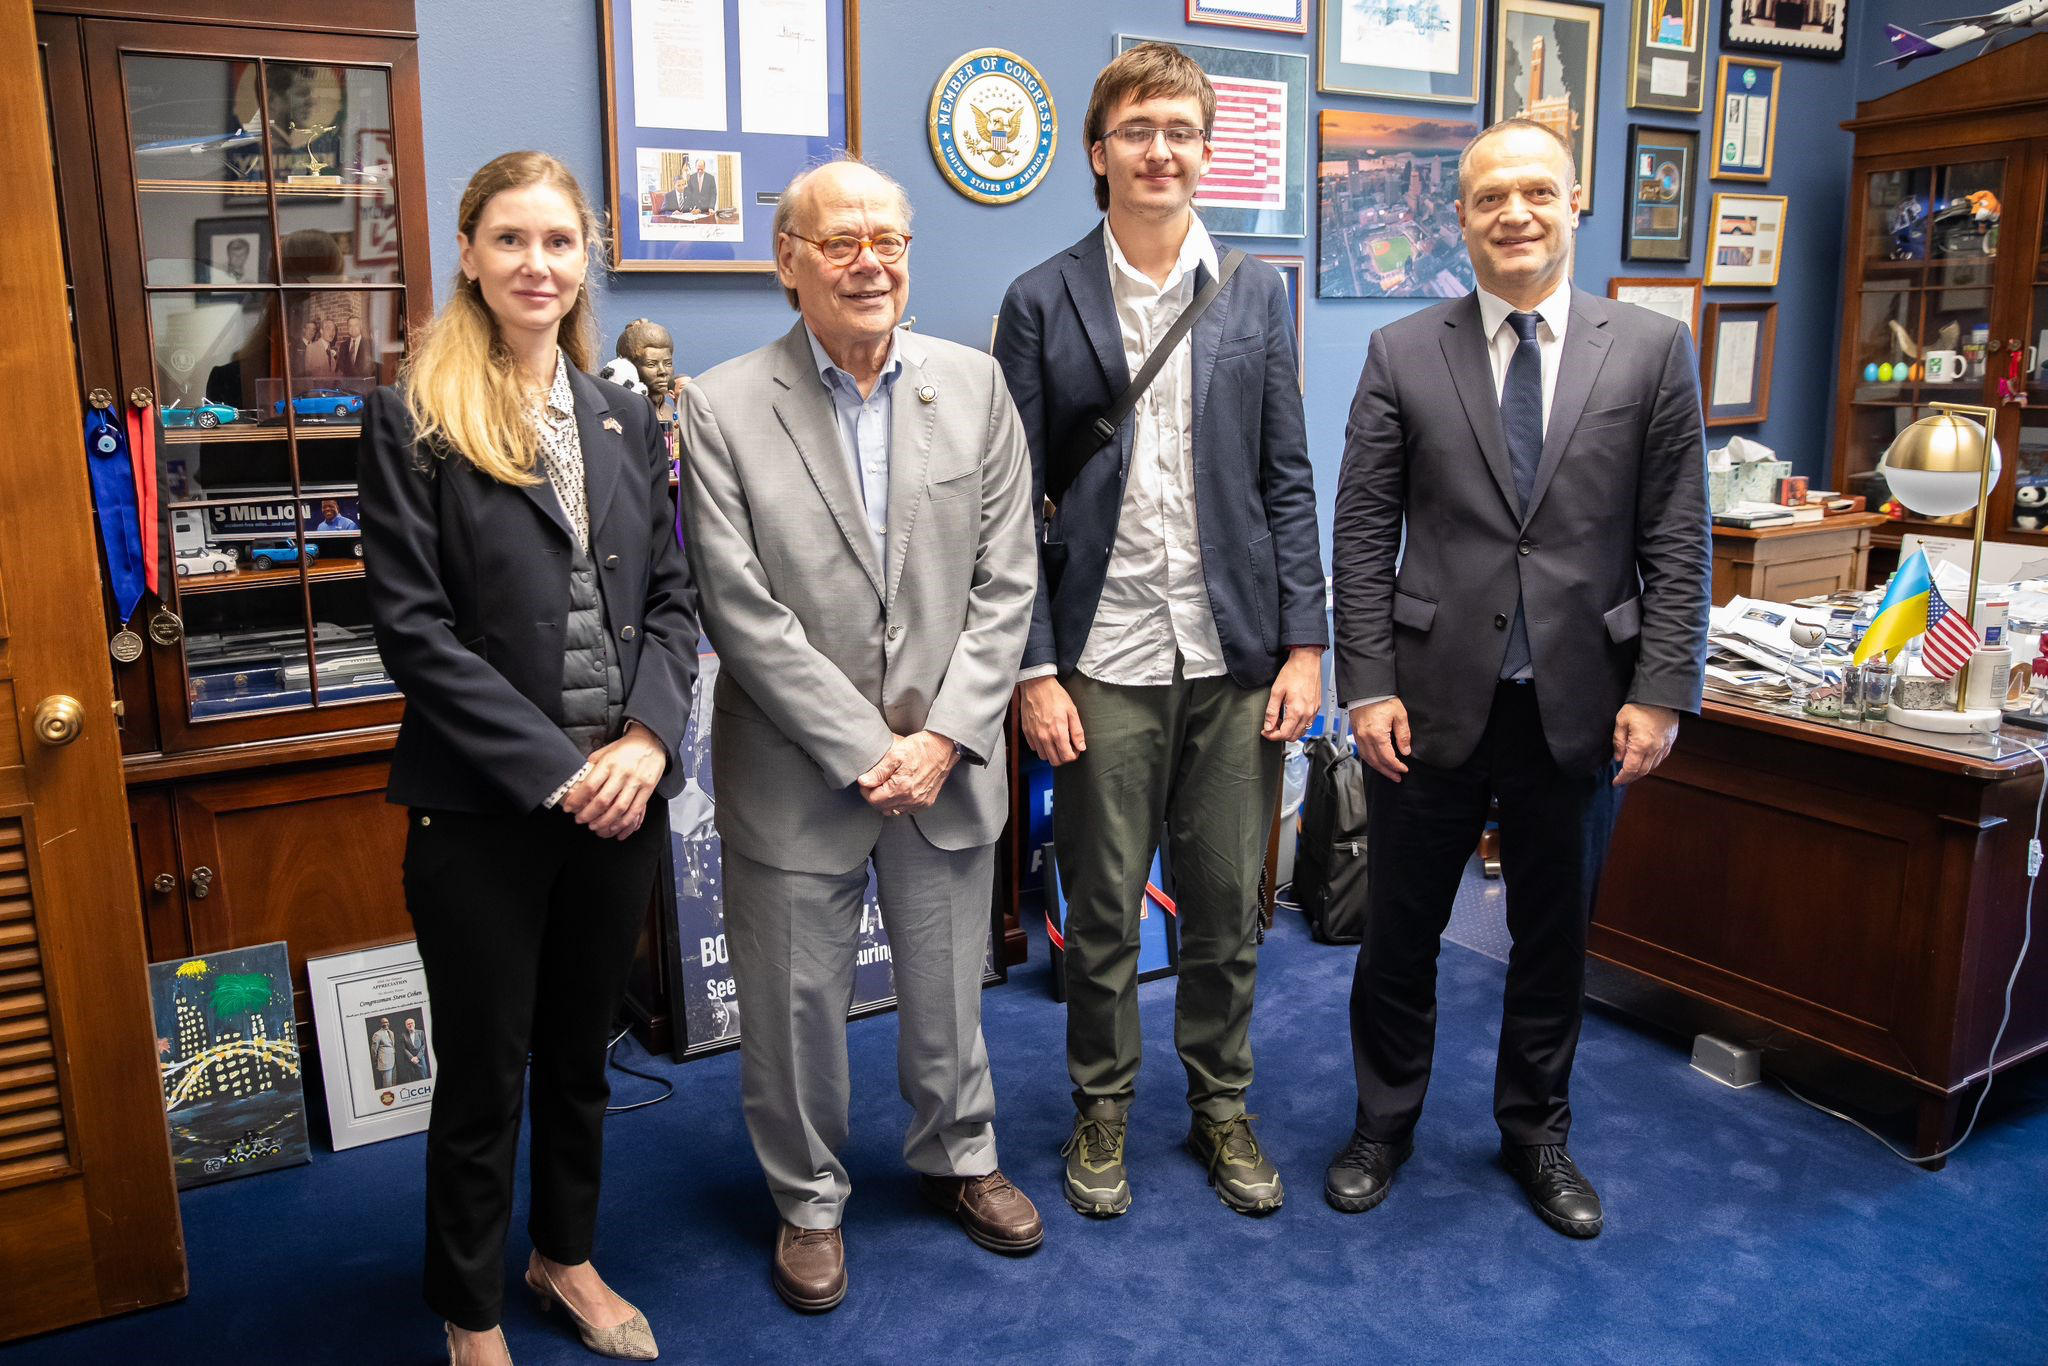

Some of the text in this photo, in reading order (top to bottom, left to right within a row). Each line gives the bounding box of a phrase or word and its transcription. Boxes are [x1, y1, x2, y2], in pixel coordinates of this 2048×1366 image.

[939, 57, 1052, 132] MEMBER OF CONGRESS
[946, 145, 1045, 192] UNITED STATES OF AMERICA
[214, 504, 311, 522] 5 MILLION
[372, 979, 408, 990] APPRECIATION
[406, 990, 423, 999] Cohen
[706, 978, 737, 1000] See
